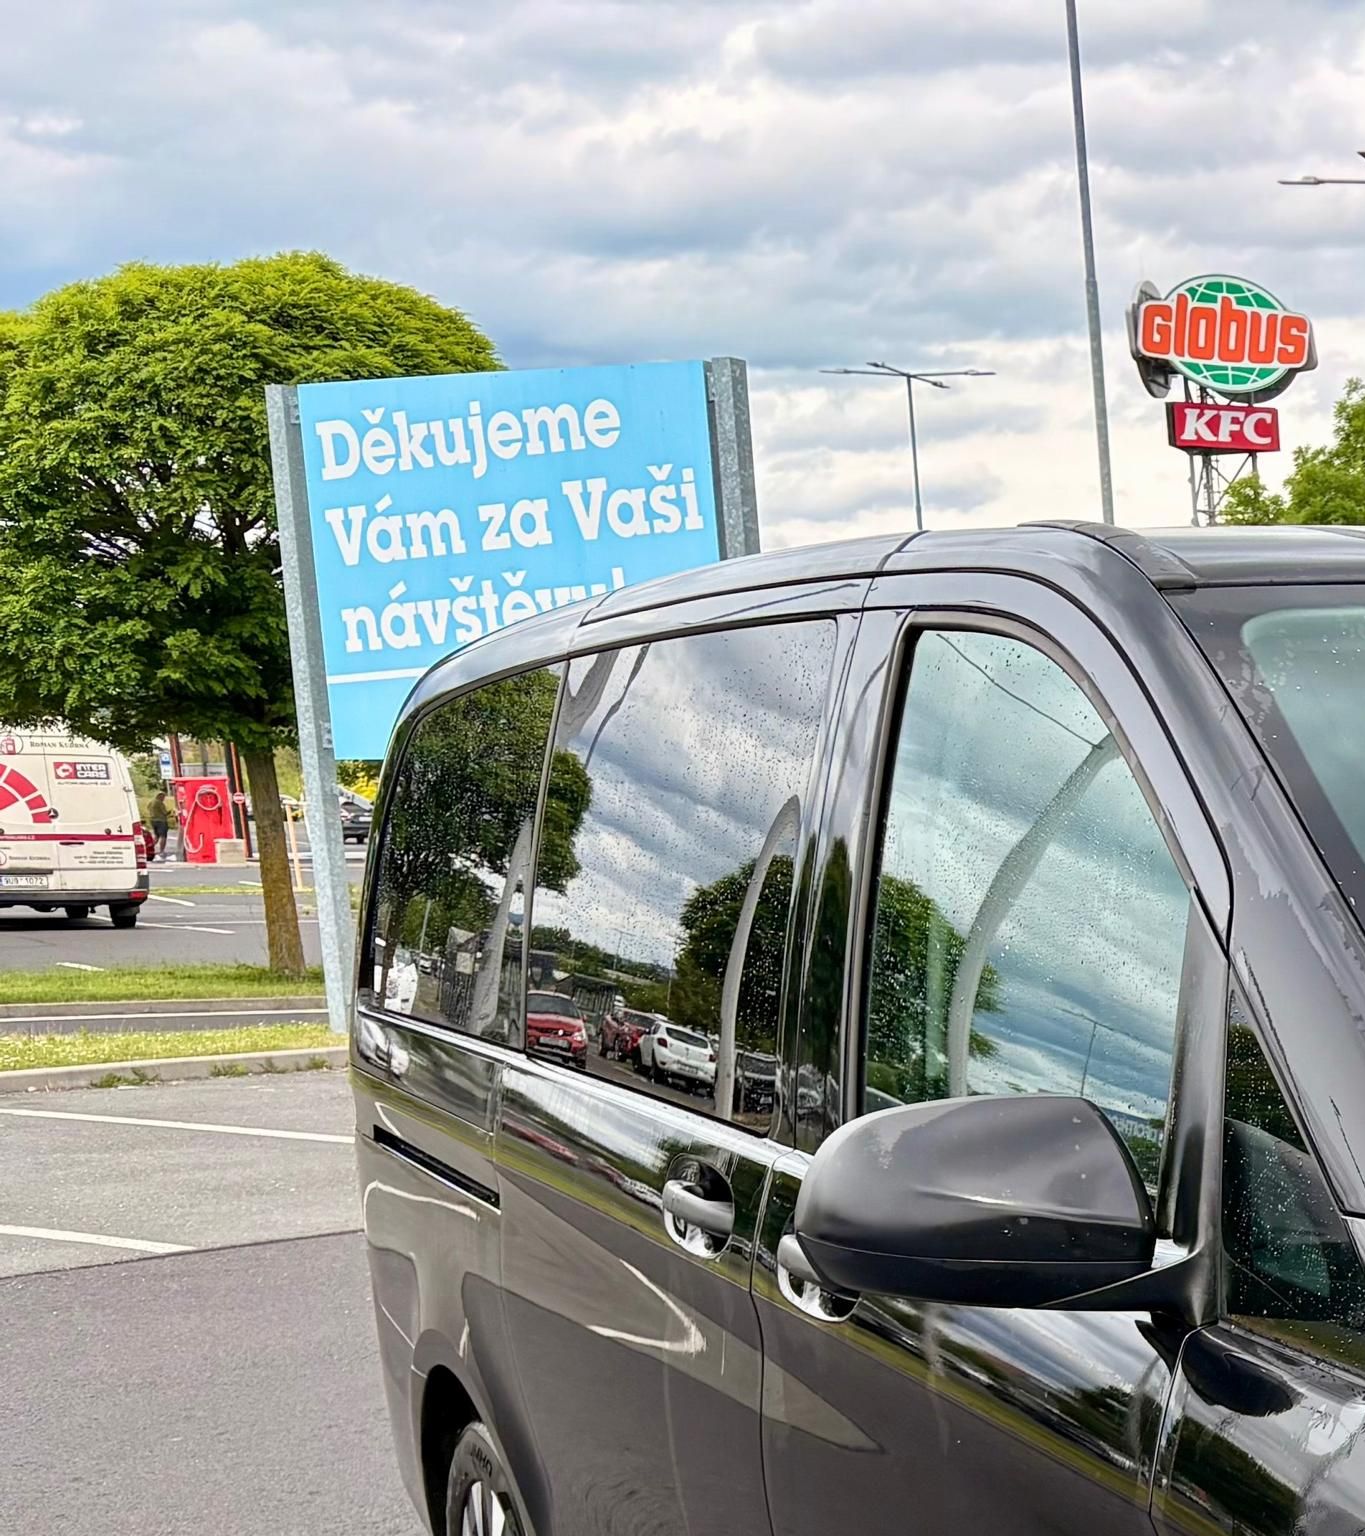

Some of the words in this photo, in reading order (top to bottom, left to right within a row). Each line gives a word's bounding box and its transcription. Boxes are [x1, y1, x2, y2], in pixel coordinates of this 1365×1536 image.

[315, 398, 621, 481] Děkujeme
[1180, 408, 1272, 445] KFC
[325, 494, 467, 567] Vám
[478, 498, 553, 551] za
[561, 464, 704, 541] Vaši
[341, 567, 625, 652] návště
